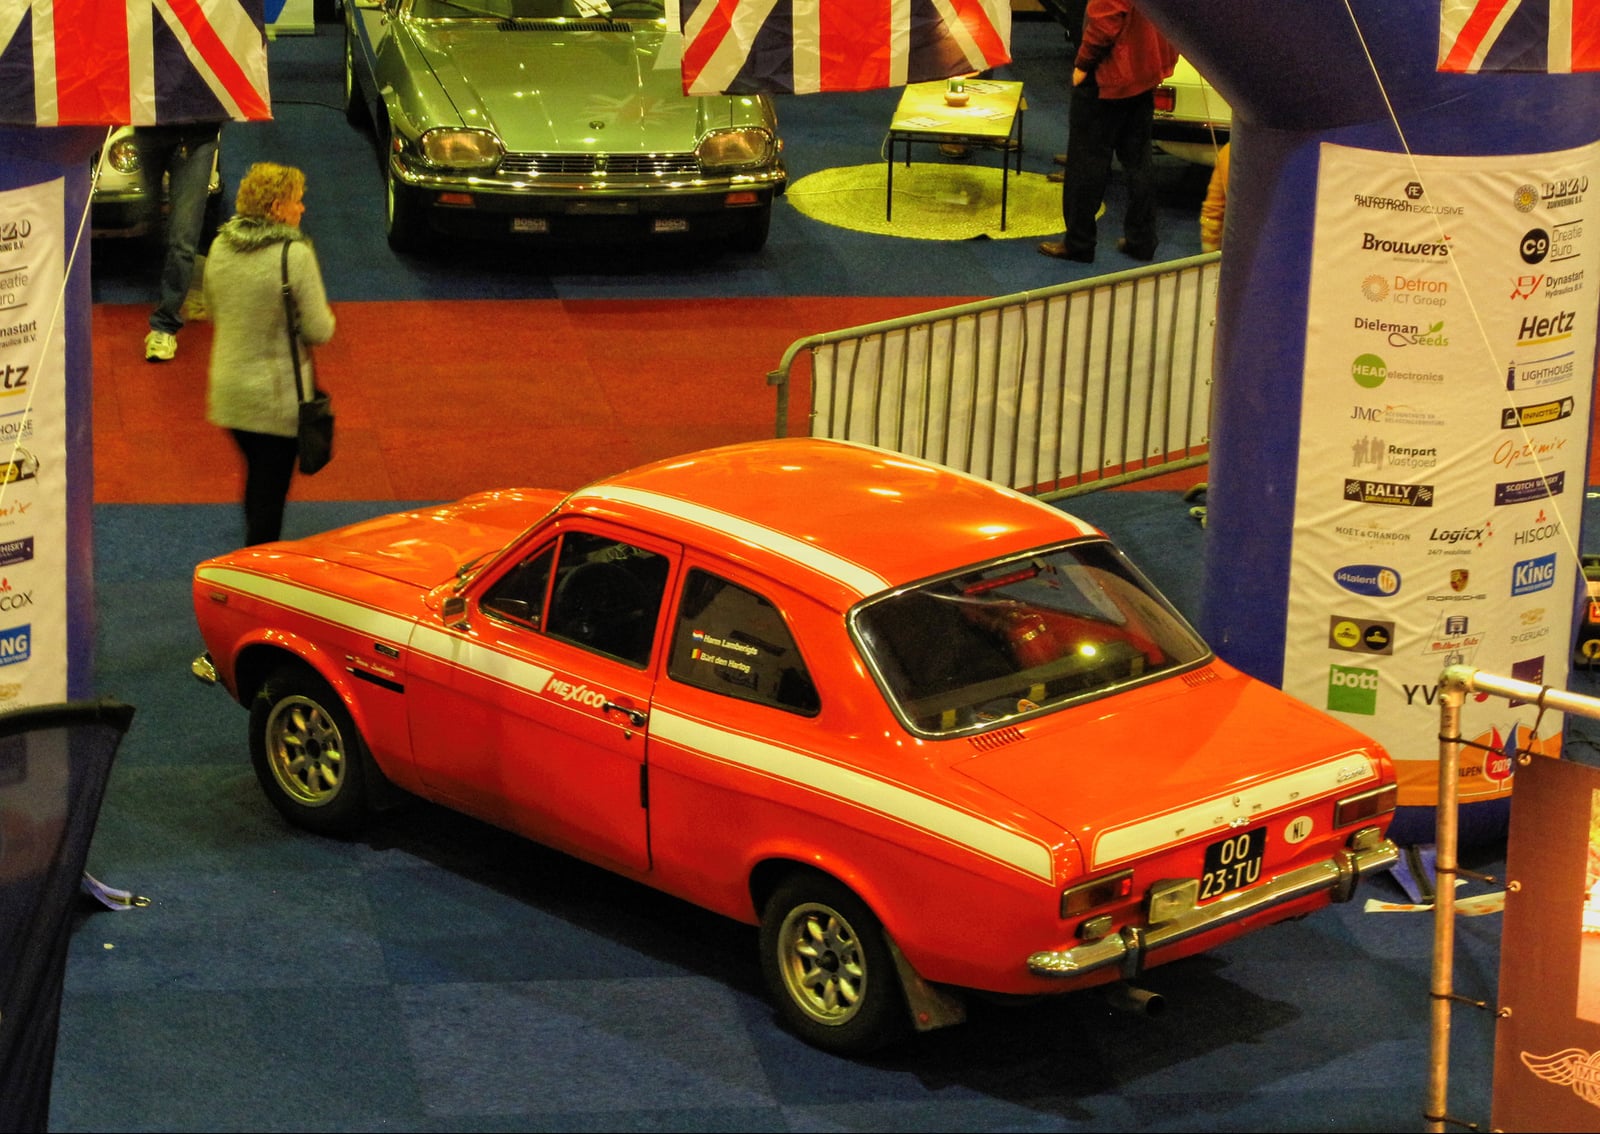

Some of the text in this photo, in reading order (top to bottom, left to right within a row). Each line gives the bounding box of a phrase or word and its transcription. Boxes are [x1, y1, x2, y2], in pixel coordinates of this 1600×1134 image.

[1362, 232, 1449, 257] Brouwers
[1394, 275, 1448, 293] Detron
[1546, 269, 1584, 289] Dynastart
[1393, 293, 1447, 307] ICT Groep
[1354, 317, 1419, 334] Dieleman
[1517, 310, 1576, 340] Hertz
[1410, 333, 1449, 347] Seeds
[1352, 363, 1445, 382] HEAD electronics
[1521, 360, 1574, 381] LIGHTHOUSE
[1350, 405, 1382, 423] JMC
[1388, 444, 1437, 458] Renpart
[1387, 455, 1437, 469] Vastgoed
[1365, 482, 1413, 498] RALLY
[1367, 530, 1411, 542] CHANDON
[1429, 527, 1485, 545] Logicx
[1513, 520, 1561, 545] HISCOX
[1336, 572, 1377, 585] i4talent
[1426, 593, 1488, 602] PORSCHE
[1331, 668, 1379, 691] bott
[547, 678, 607, 709] MEXICO
[1292, 821, 1305, 841] NL
